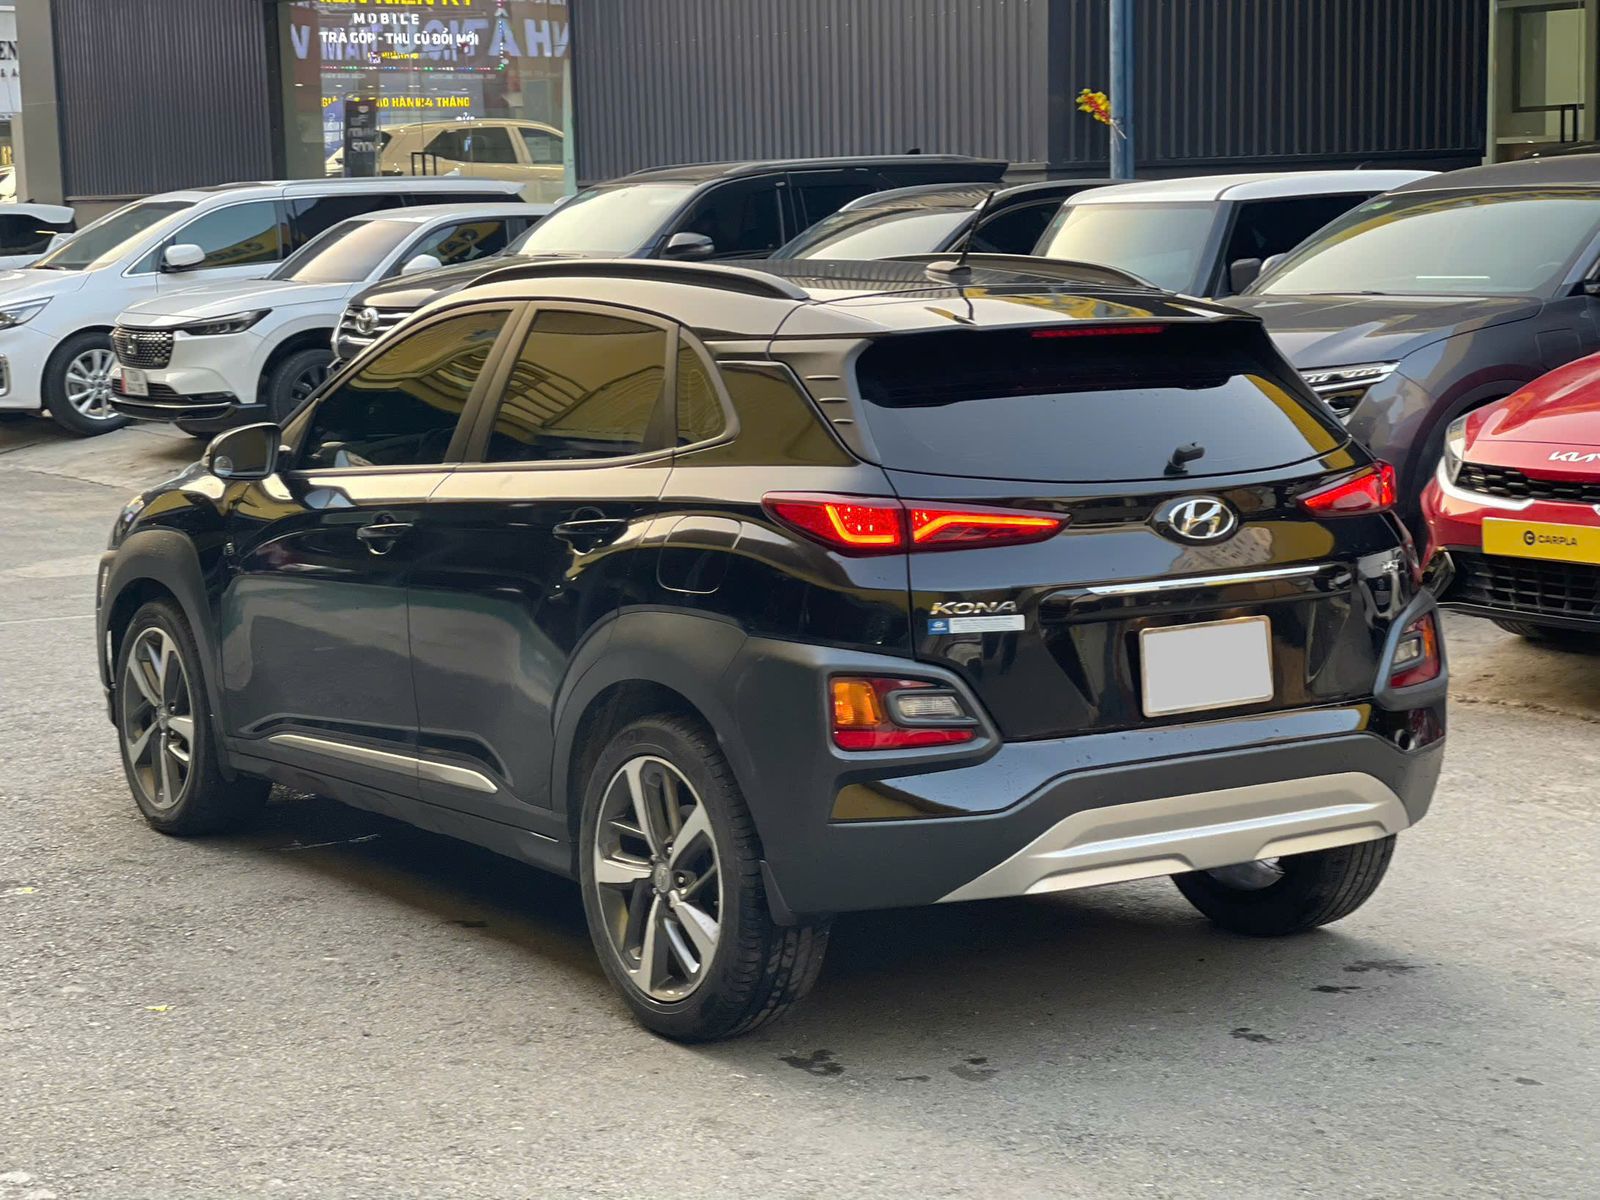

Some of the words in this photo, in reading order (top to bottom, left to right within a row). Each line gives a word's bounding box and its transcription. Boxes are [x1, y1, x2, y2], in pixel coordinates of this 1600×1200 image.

[353, 12, 420, 25] MOBILE
[384, 32, 410, 44] THU
[1538, 534, 1578, 546] CARPLA
[929, 601, 1017, 615] KONA
